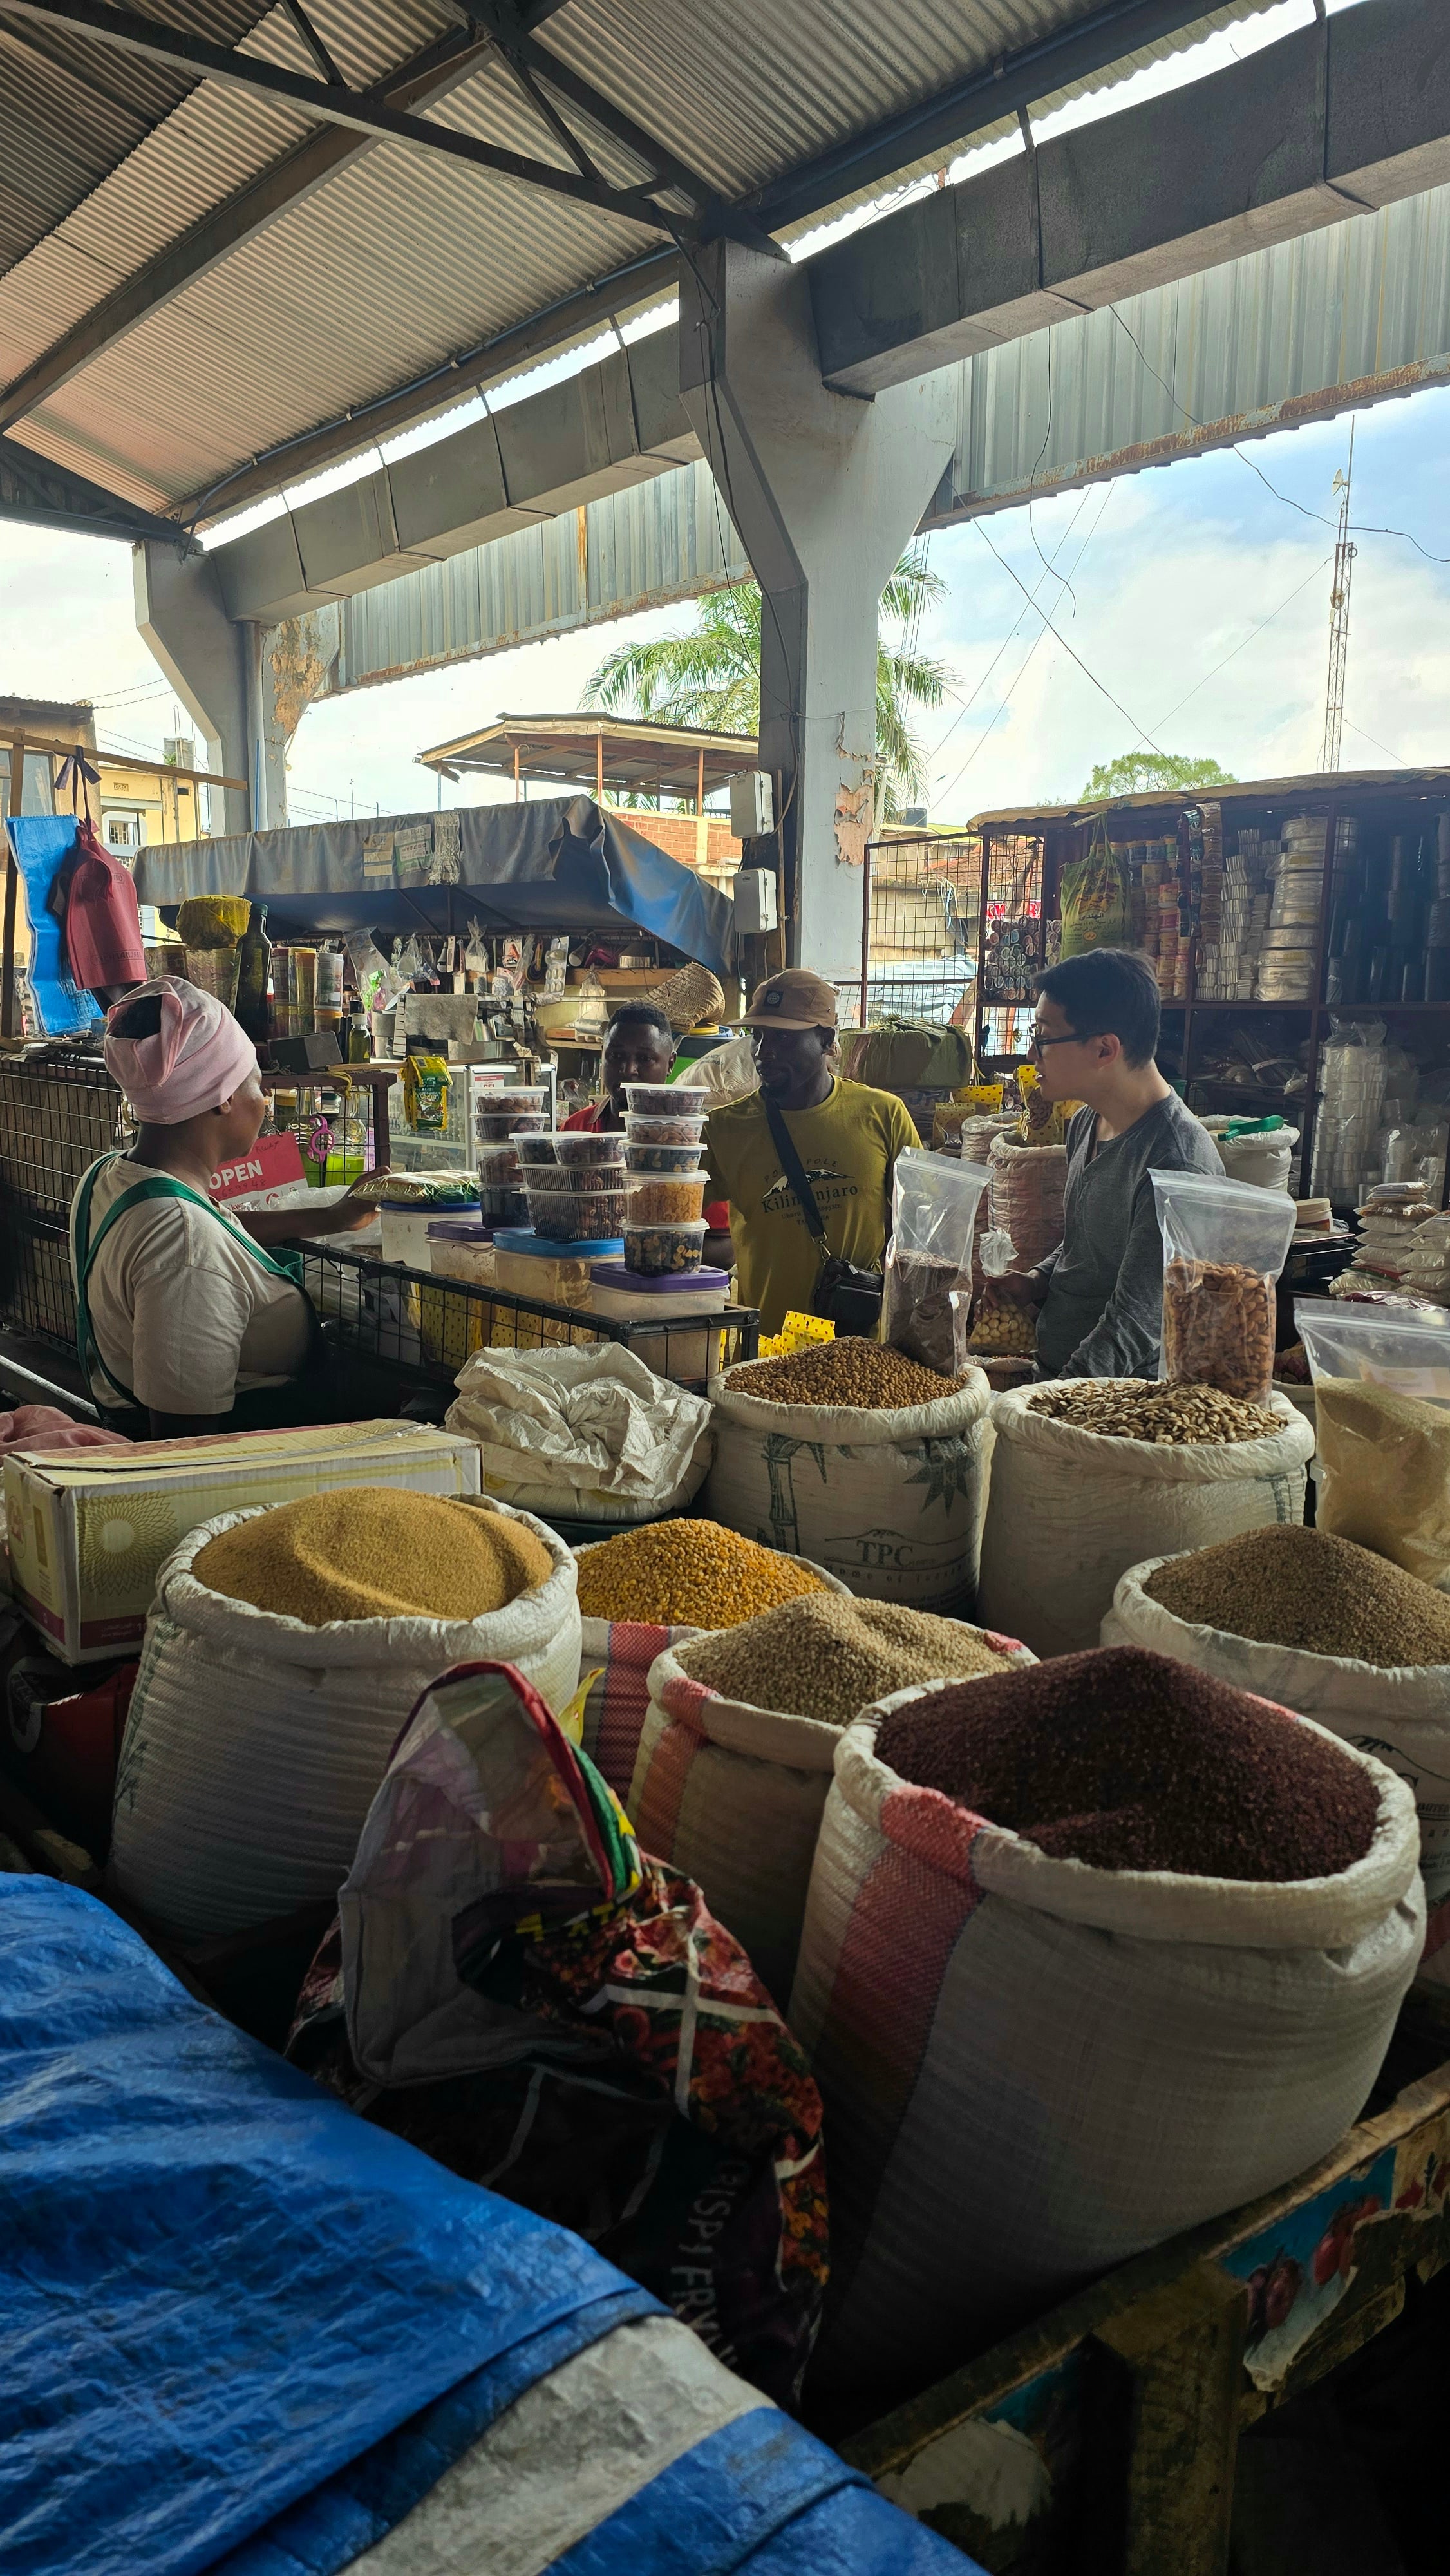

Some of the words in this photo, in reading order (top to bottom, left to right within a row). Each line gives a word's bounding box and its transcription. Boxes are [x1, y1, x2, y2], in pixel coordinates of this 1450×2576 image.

[209, 1160, 263, 1189] OPEN
[762, 1186, 859, 1213] Kilimnjaro
[856, 1540, 913, 1567] TPC
